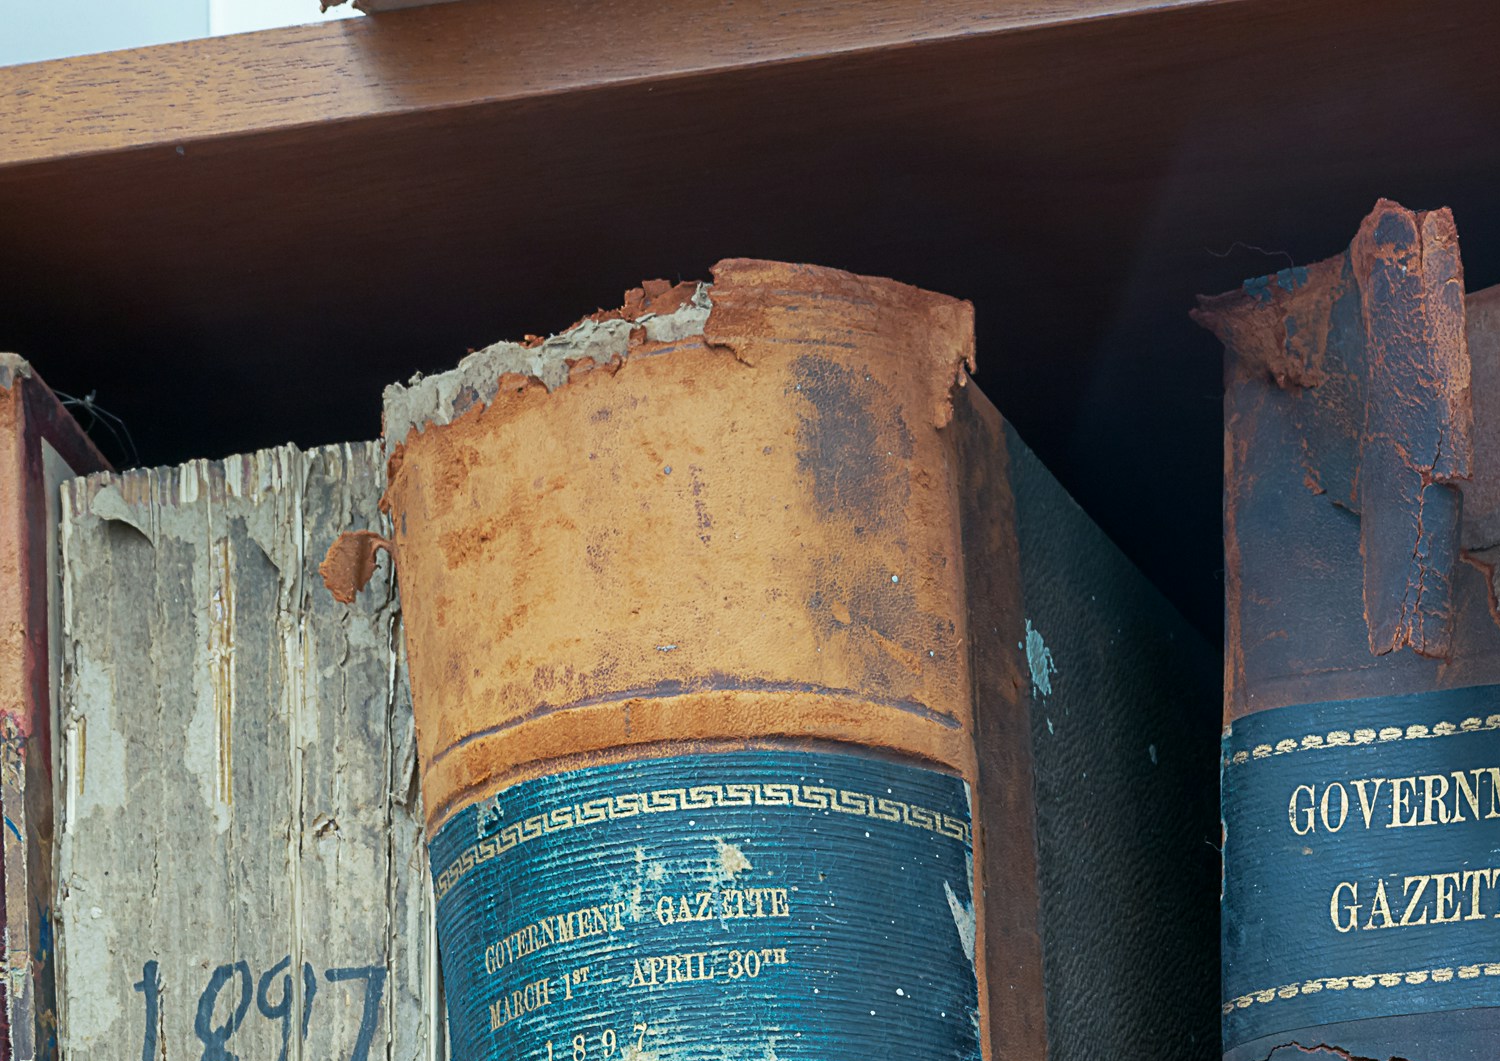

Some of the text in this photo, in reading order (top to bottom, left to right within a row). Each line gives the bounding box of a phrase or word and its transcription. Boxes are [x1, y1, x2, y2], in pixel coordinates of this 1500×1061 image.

[485, 888, 790, 975] GOVERNMENT GAZETTE
[488, 977, 551, 1033] MARCH
[629, 952, 716, 988] APRIL
[728, 948, 789, 979] 30TH
